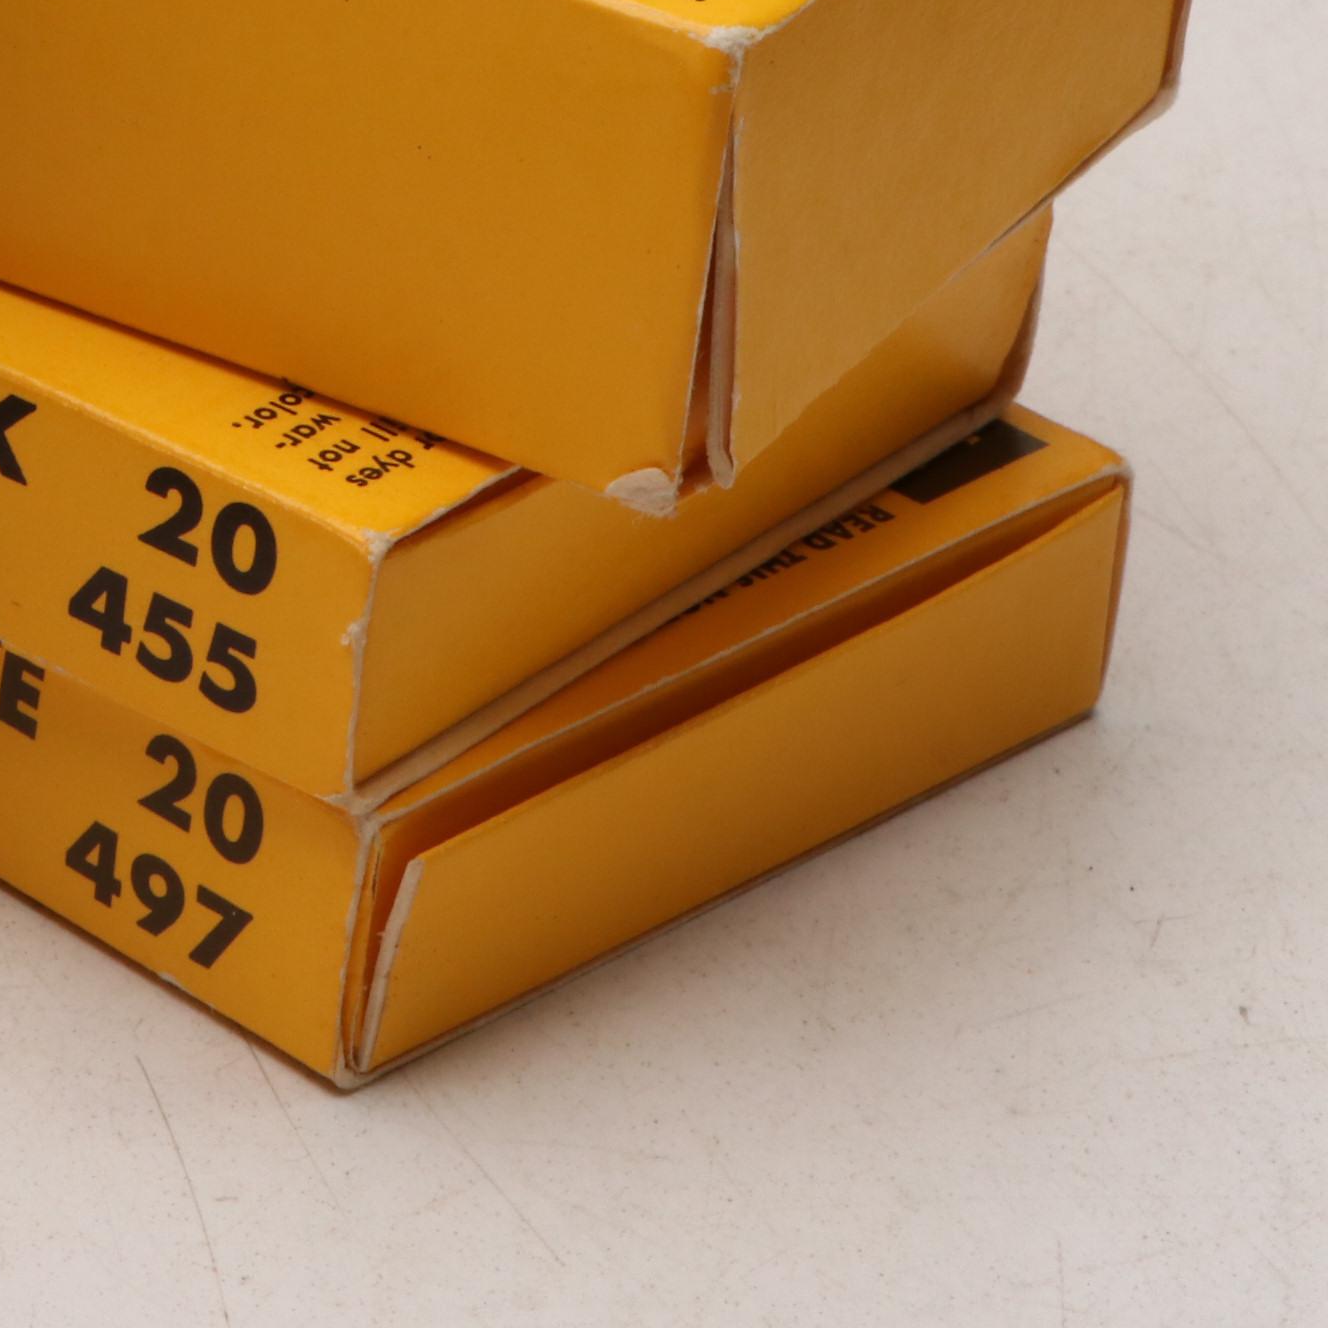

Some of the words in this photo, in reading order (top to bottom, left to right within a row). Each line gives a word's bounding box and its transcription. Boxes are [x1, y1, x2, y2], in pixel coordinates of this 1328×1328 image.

[275, 413, 341, 449] war-
[308, 439, 361, 471] not
[345, 449, 415, 487] dyes
[137, 466, 278, 596] 20
[802, 504, 896, 549] READ
[68, 566, 258, 714] 455
[137, 733, 265, 865] 20
[64, 819, 253, 969] 497
